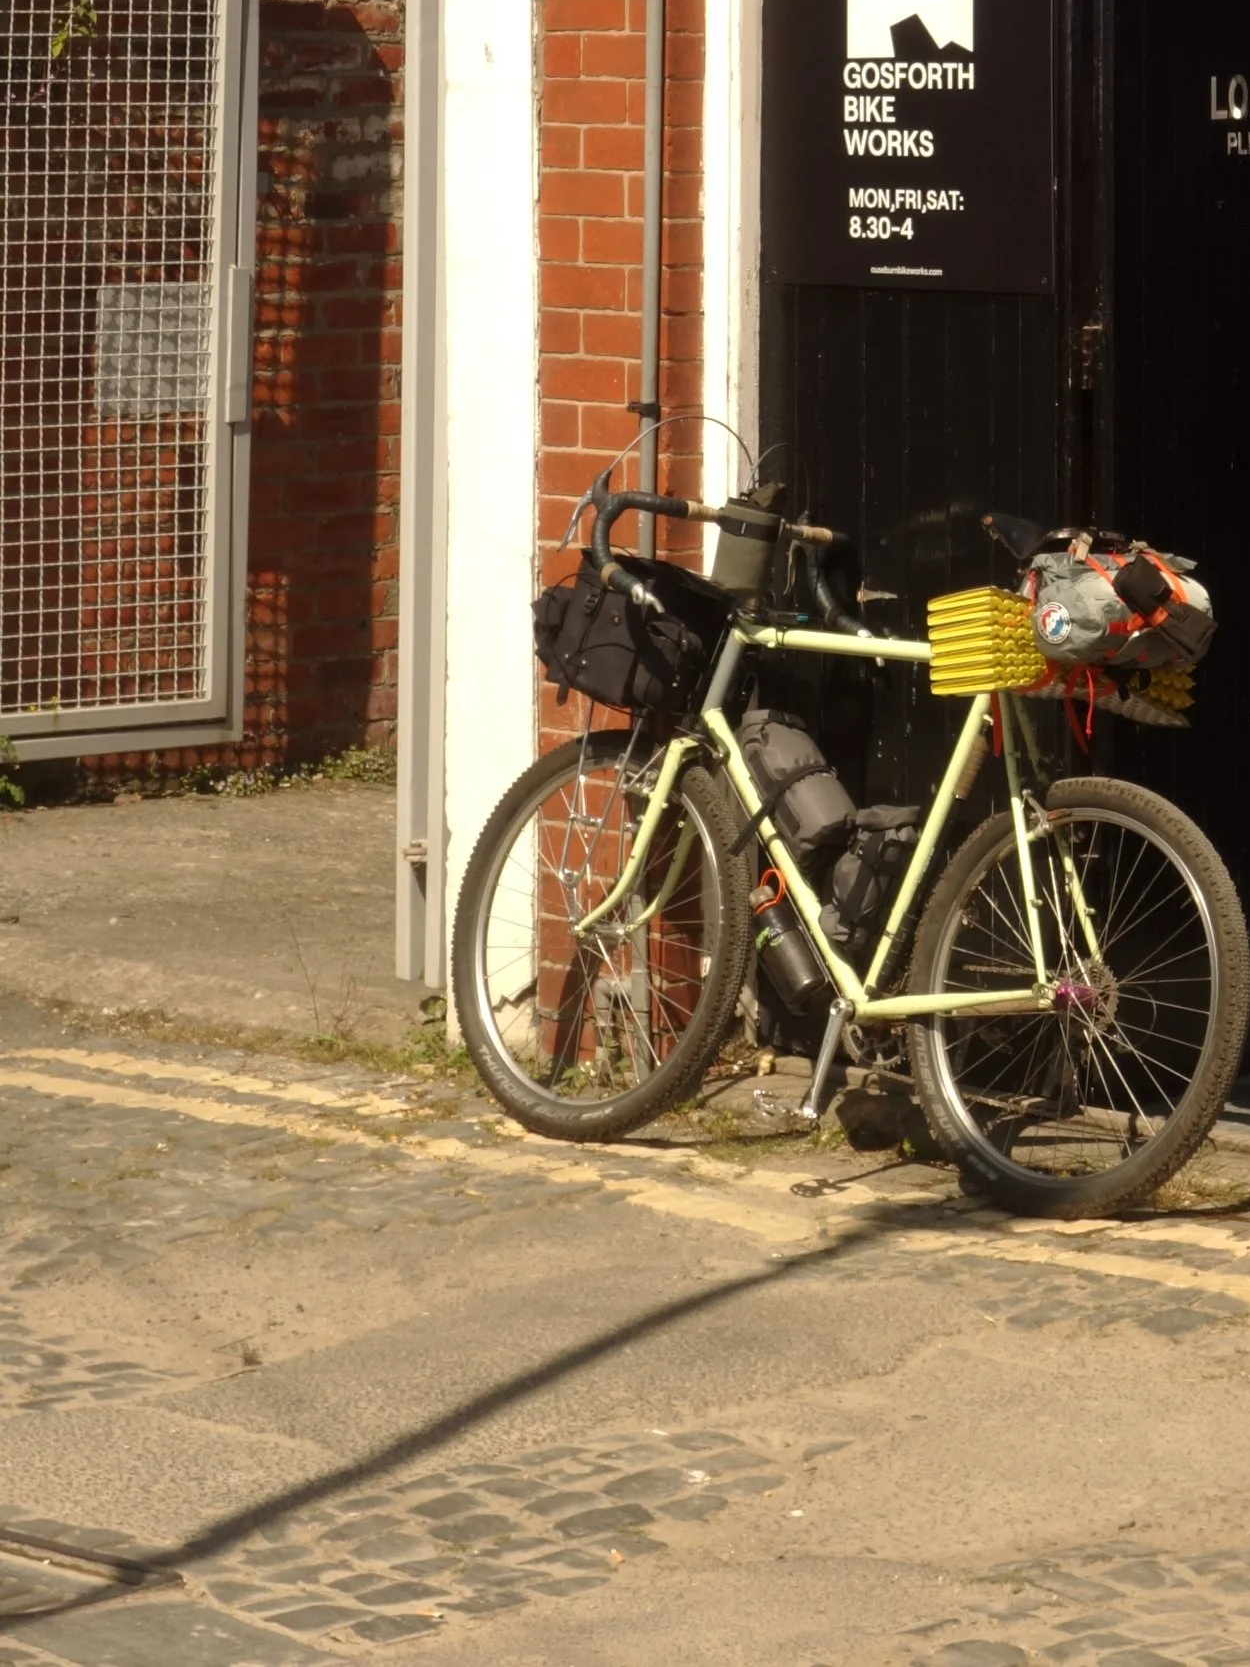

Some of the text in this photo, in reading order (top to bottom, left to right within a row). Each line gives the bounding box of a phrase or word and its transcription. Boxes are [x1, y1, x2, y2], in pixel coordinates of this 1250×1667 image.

[843, 62, 974, 90] GOSFORTH
[844, 96, 895, 122] BIKE
[844, 129, 934, 157] WORKS
[849, 188, 964, 213] MON,FRI,SAT:
[849, 217, 914, 240] 8.30-4
